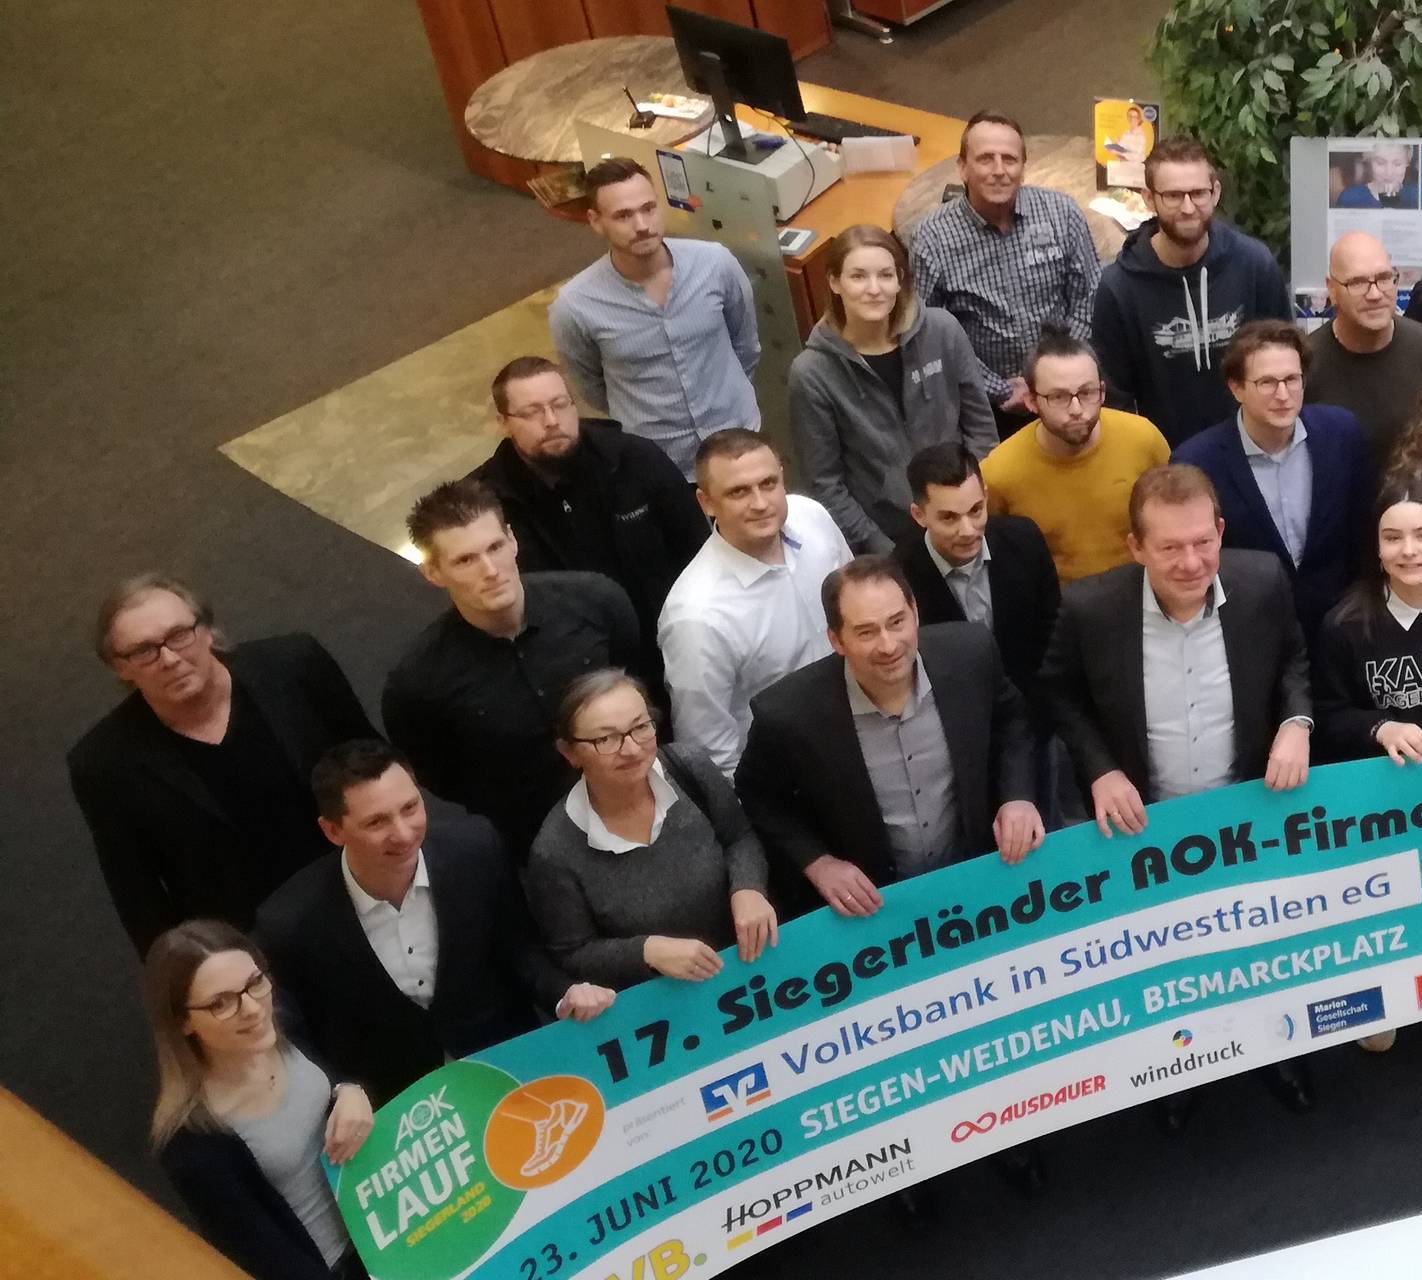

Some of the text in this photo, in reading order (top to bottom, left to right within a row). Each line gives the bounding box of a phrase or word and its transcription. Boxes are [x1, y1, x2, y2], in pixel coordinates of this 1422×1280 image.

[597, 1019, 700, 1084] 17.
[717, 870, 1110, 1035] Siegerländer
[781, 873, 1392, 1076] Volksbank in Südwestfalen eG
[1315, 1003, 1369, 1024] Gesellschaft
[520, 1243, 578, 1280] 23.
[586, 1175, 678, 1245] JUNI
[690, 1128, 783, 1191] 2020
[1143, 925, 1408, 1015] BISMARCKPLATZ
[1000, 1074, 1106, 1125] AUSDAUER
[1130, 1040, 1245, 1089] winddruck
[355, 1112, 467, 1210] FIRMEN
[395, 1085, 455, 1151] AOK
[365, 1141, 477, 1251] LAUF
[721, 1138, 912, 1234] HOPPMANN
[821, 1158, 915, 1207] autowelt
